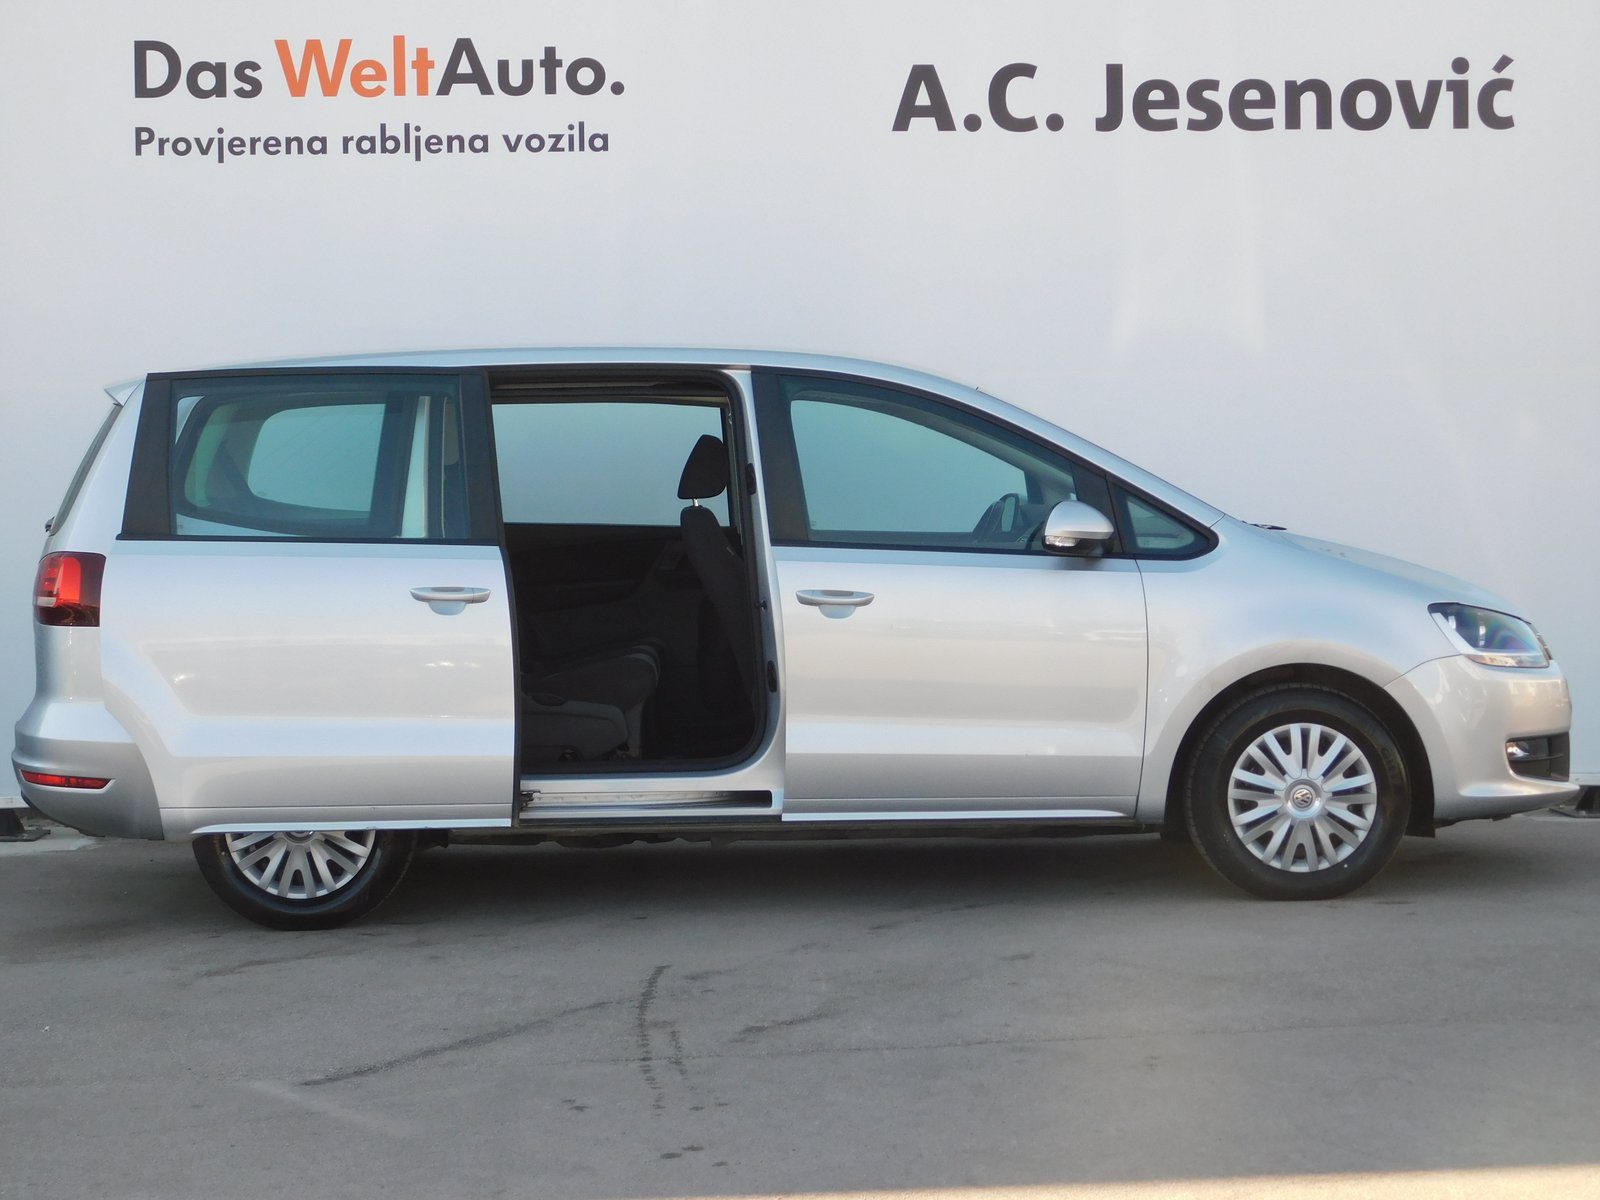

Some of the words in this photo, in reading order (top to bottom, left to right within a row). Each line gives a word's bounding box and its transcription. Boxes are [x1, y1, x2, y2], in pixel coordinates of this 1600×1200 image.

[134, 39, 263, 99] Das
[275, 35, 625, 97] WeltAuto.
[891, 62, 1064, 133] A.C.
[1095, 54, 1515, 132] Jesenović
[134, 126, 328, 164] Provjerena
[342, 122, 489, 162] rabljena
[502, 121, 609, 153] vozila
